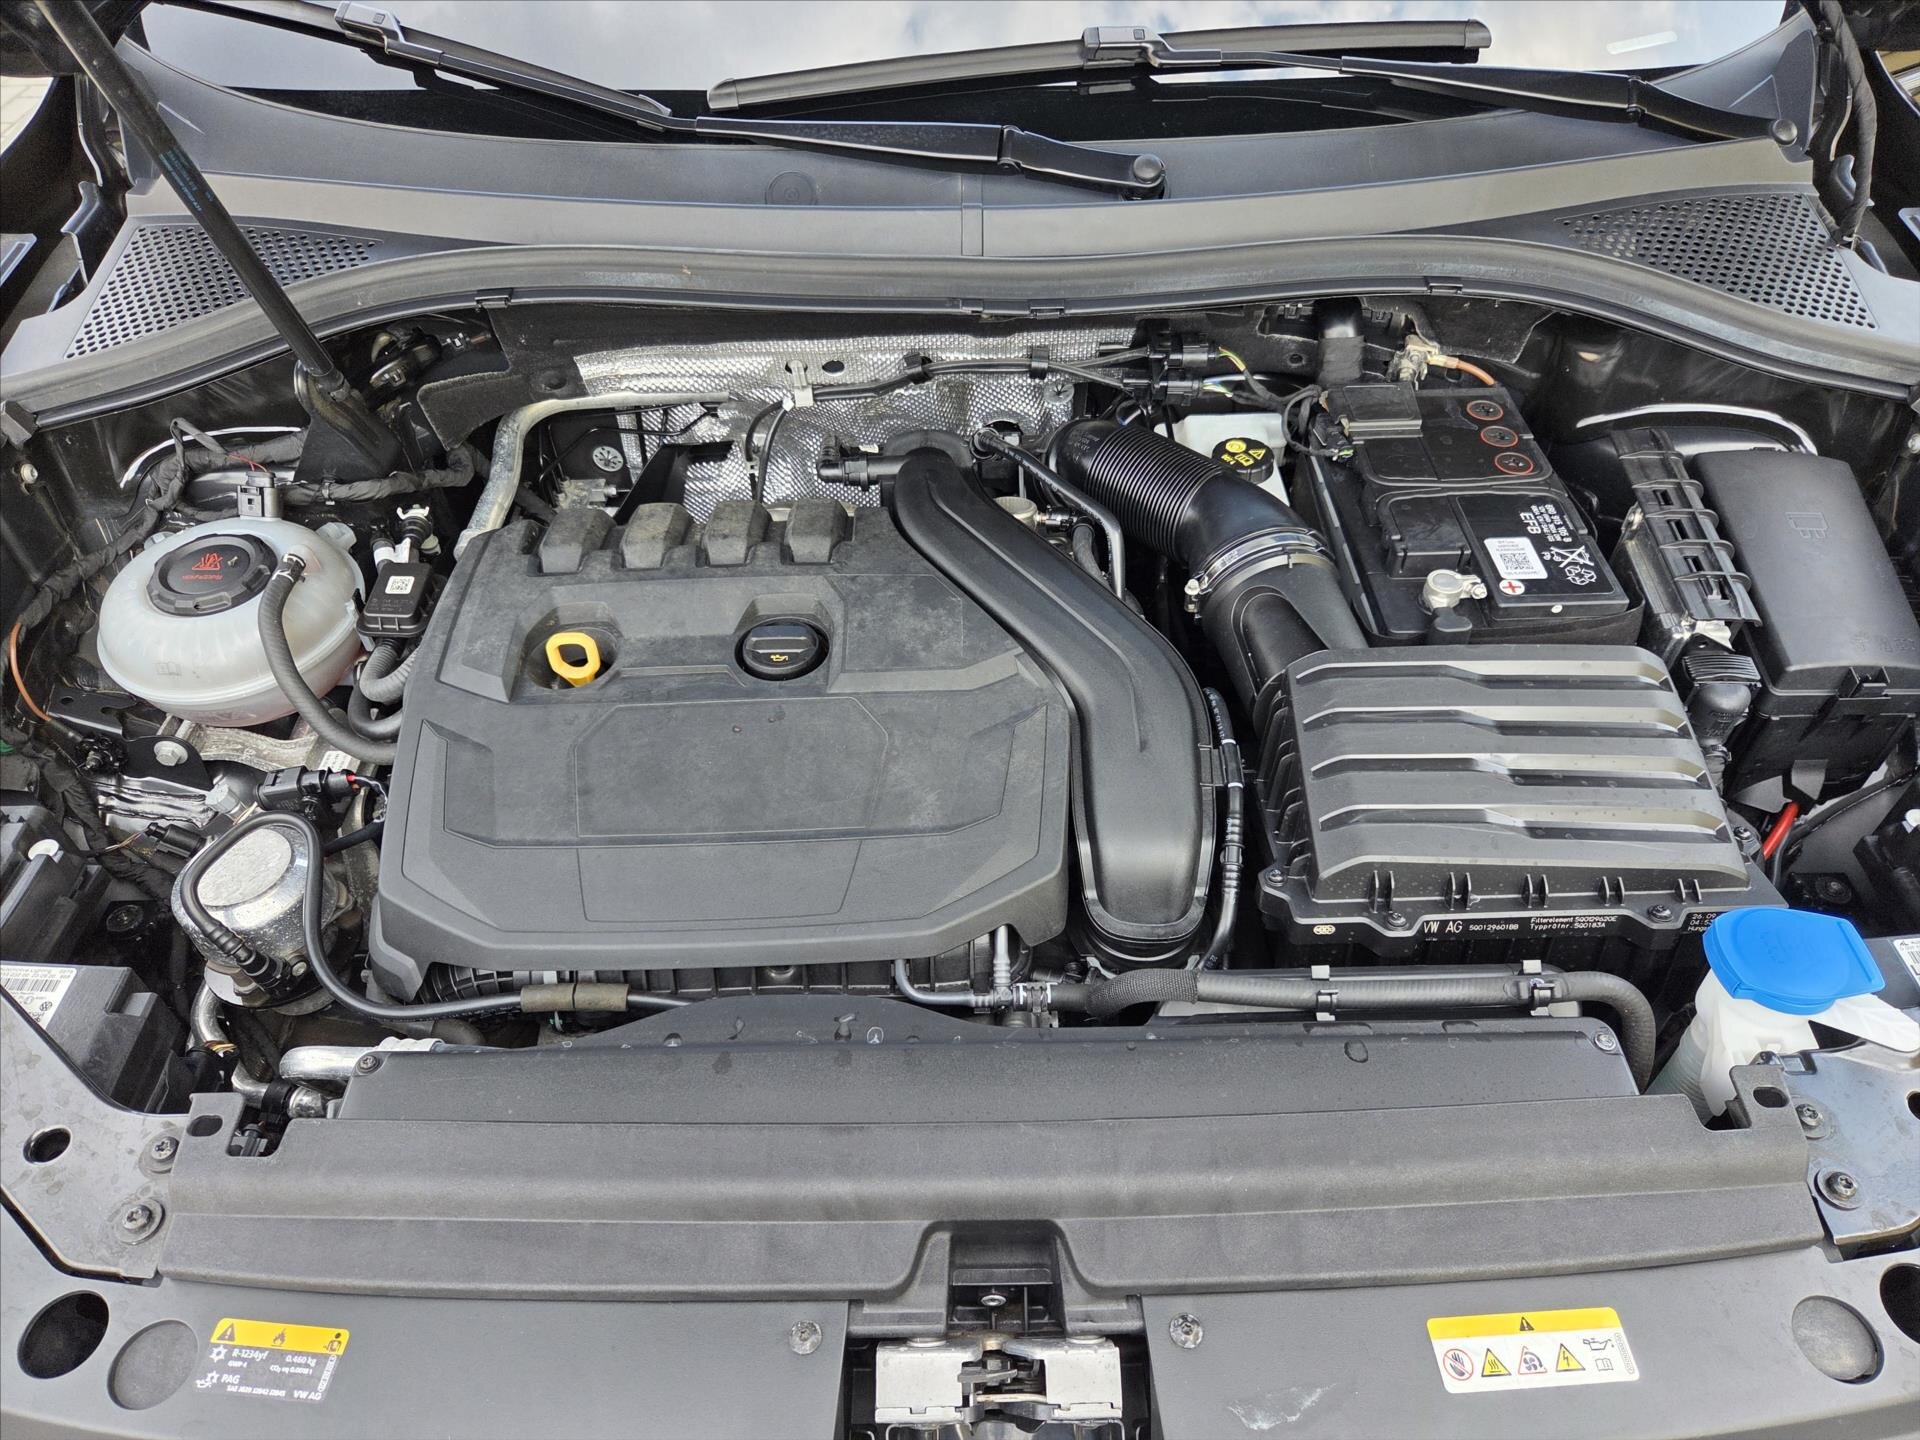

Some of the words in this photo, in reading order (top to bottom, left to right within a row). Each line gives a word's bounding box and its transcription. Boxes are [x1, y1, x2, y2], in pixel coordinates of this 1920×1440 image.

[1520, 512, 1541, 534] EFB
[1423, 921, 1440, 933] VW
[1445, 920, 1463, 933] AG
[232, 1348, 269, 1361] R-1234yf
[307, 1356, 317, 1367] kg
[221, 1374, 240, 1384] PAG
[294, 1390, 309, 1399] VW
[308, 1391, 322, 1400] AG
